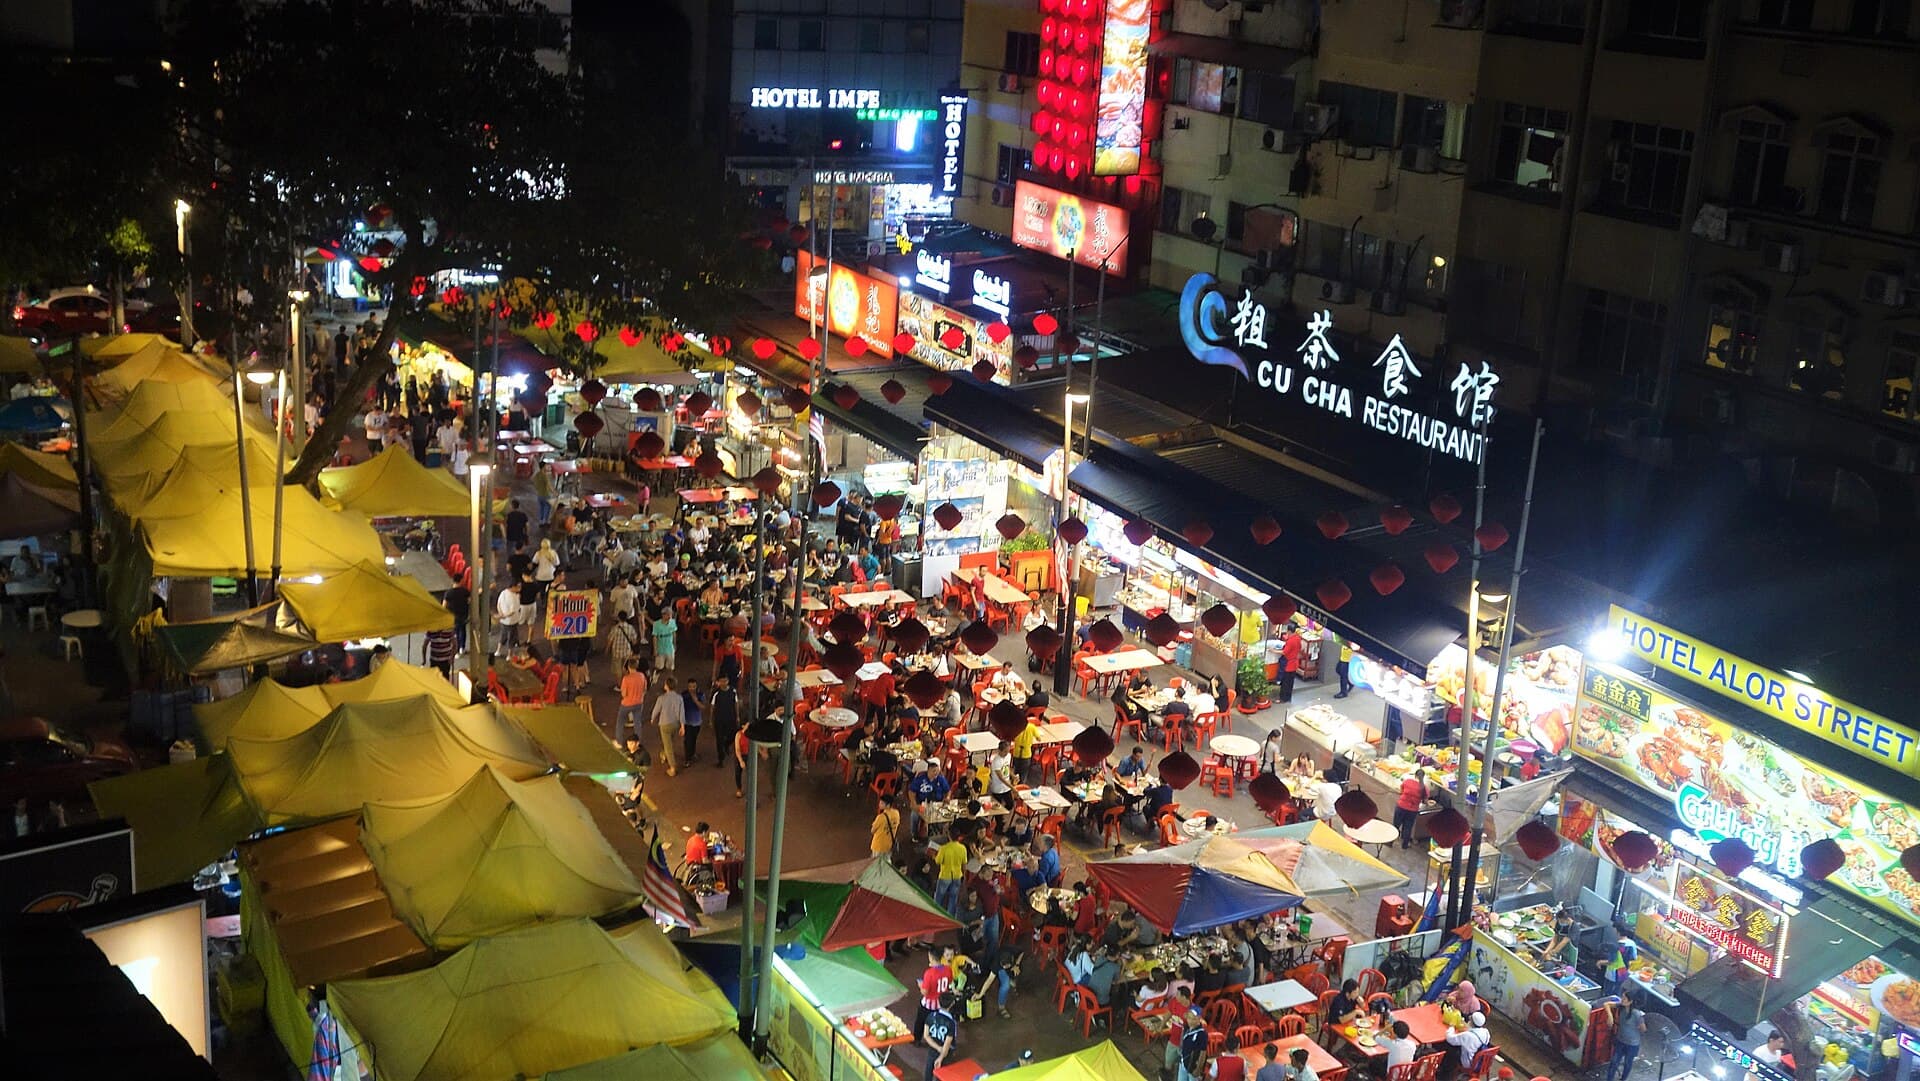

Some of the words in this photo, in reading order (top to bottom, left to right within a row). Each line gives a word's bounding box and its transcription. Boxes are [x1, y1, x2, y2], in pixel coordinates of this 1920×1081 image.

[751, 87, 822, 109] HOTEL
[943, 103, 963, 192] HOTEL
[1257, 360, 1292, 394] CU
[1302, 376, 1353, 419] CHA
[1363, 395, 1488, 465] RESTAURANT
[553, 594, 559, 613] 1
[563, 615, 588, 635] 20
[1592, 674, 1642, 712] 金金金
[1622, 616, 1703, 676] HOTEL
[1708, 657, 1785, 711] ALOR
[1794, 692, 1914, 763] STREET
[1677, 783, 1776, 863] Carlsberg
[1676, 908, 1706, 933] TRIPLE
[1706, 924, 1730, 946] GOLD
[1729, 938, 1773, 968] KITCHEN
[1683, 876, 1774, 944] 金金金
[937, 976, 948, 993] 10
